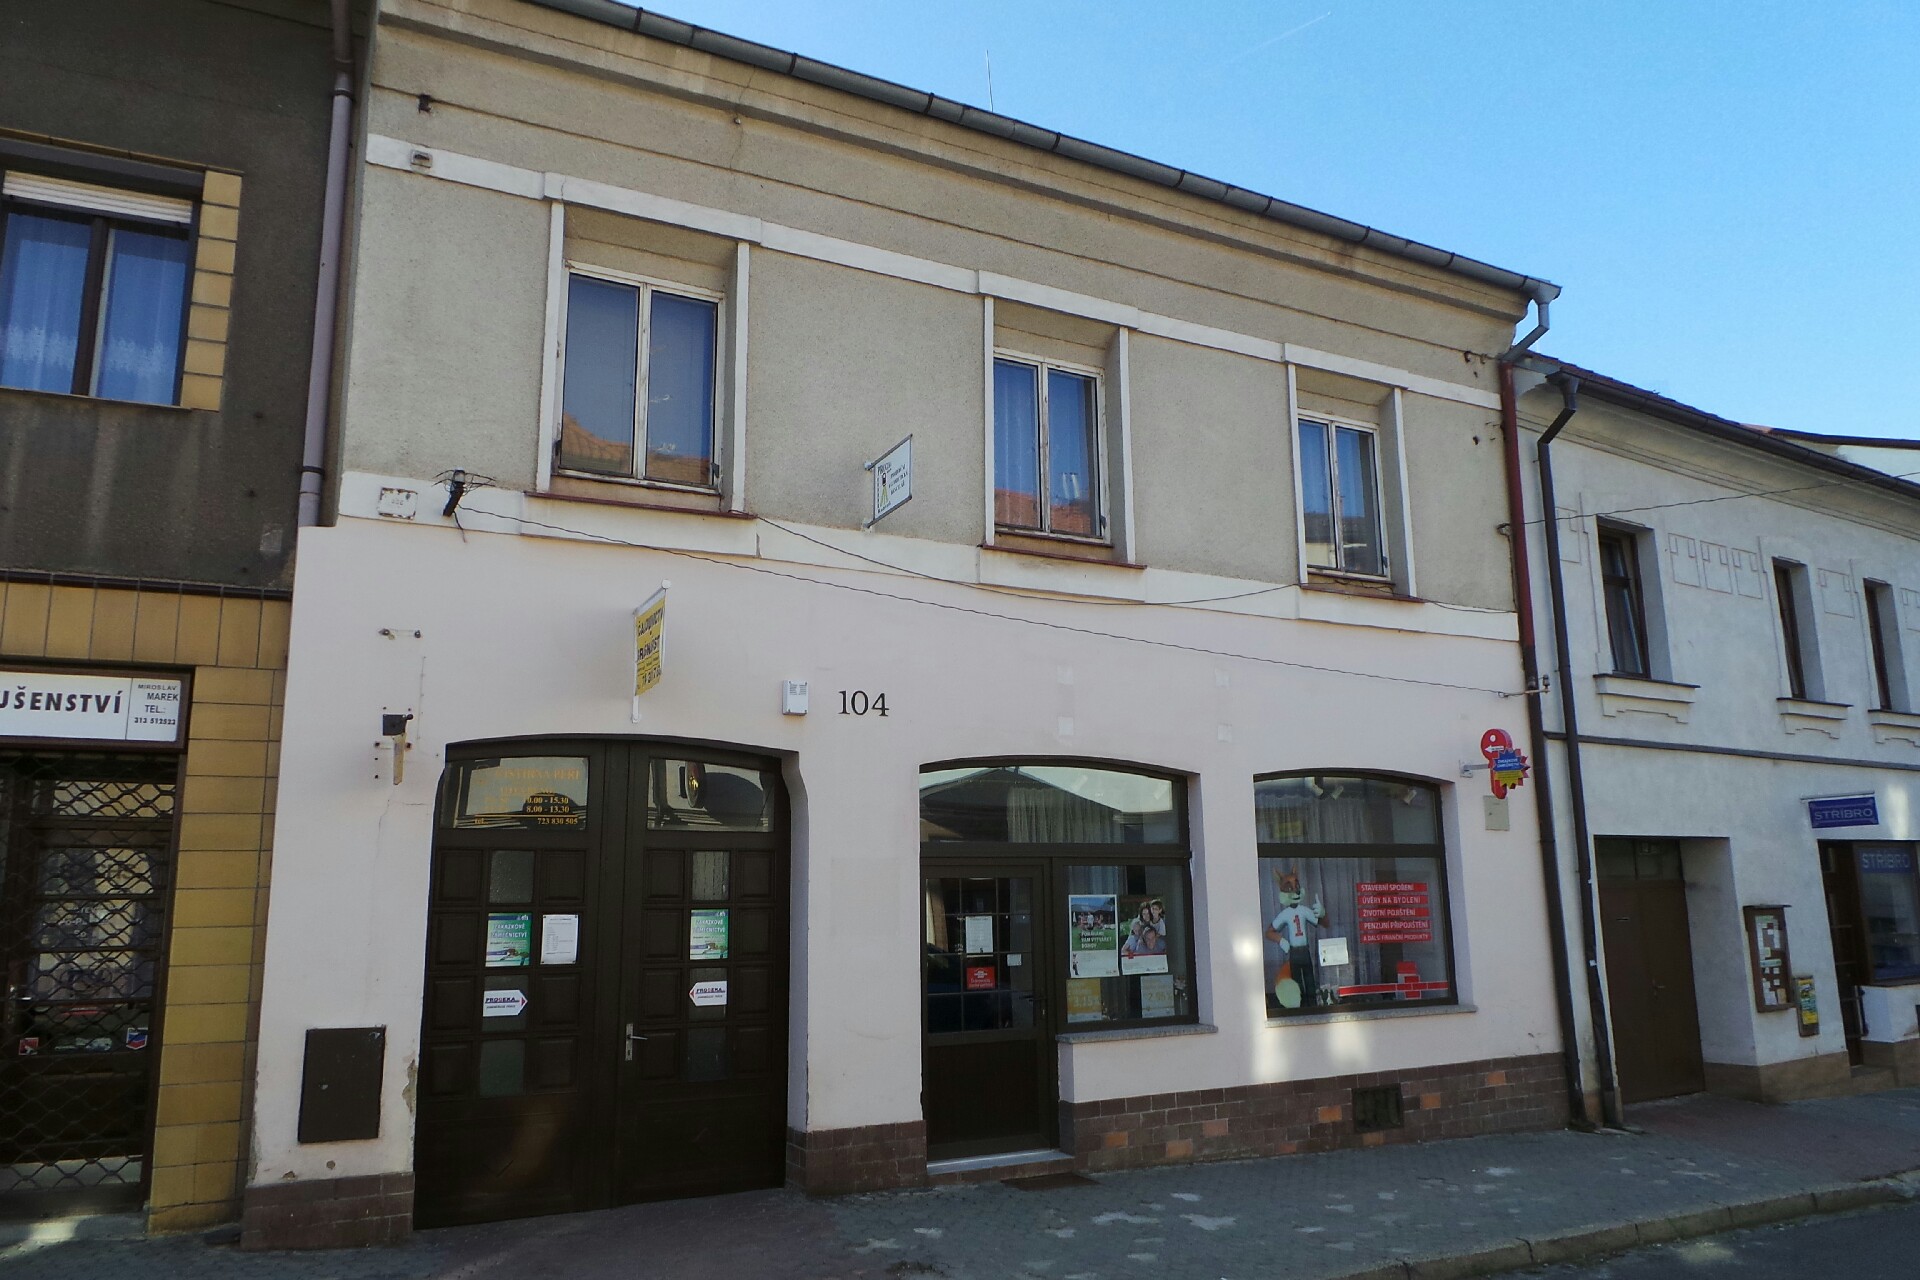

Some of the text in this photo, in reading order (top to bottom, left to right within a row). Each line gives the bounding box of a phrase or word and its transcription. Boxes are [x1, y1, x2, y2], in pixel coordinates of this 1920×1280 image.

[0, 685, 123, 714] UŠENSTVÍ
[147, 692, 179, 702] MAREK
[838, 690, 890, 717] 104
[526, 805, 543, 813] 8.00
[550, 805, 570, 813] 13.30
[537, 817, 549, 825] 723
[551, 817, 564, 825] 830
[565, 817, 578, 825] 505
[1361, 883, 1389, 891] STAVEBNÍ
[1362, 895, 1421, 904] ÚVĚRY NA BYDLENÍ
[1363, 908, 1386, 917] ŽIVOTNÍ
